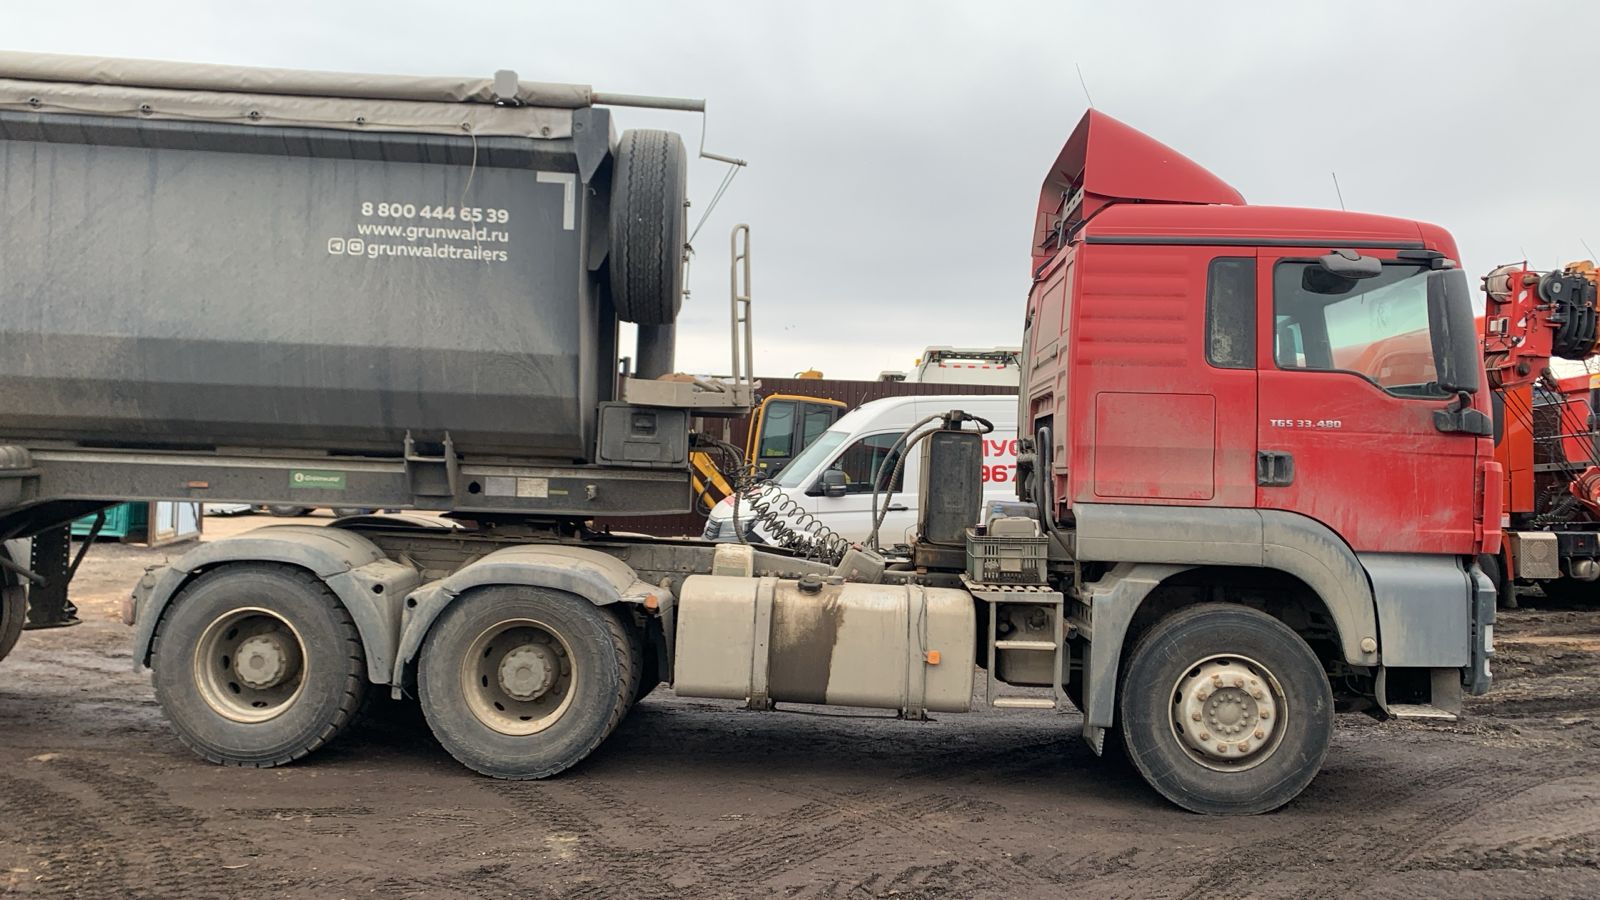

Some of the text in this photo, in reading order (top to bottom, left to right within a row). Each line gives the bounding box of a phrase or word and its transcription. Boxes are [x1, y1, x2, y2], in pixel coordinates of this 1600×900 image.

[361, 202, 509, 224] 8 800 444 65 39
[357, 223, 509, 243] www.grunwald.ru
[367, 242, 508, 262] grunwaldtrailers
[1270, 419, 1342, 428] TGS 33.480
